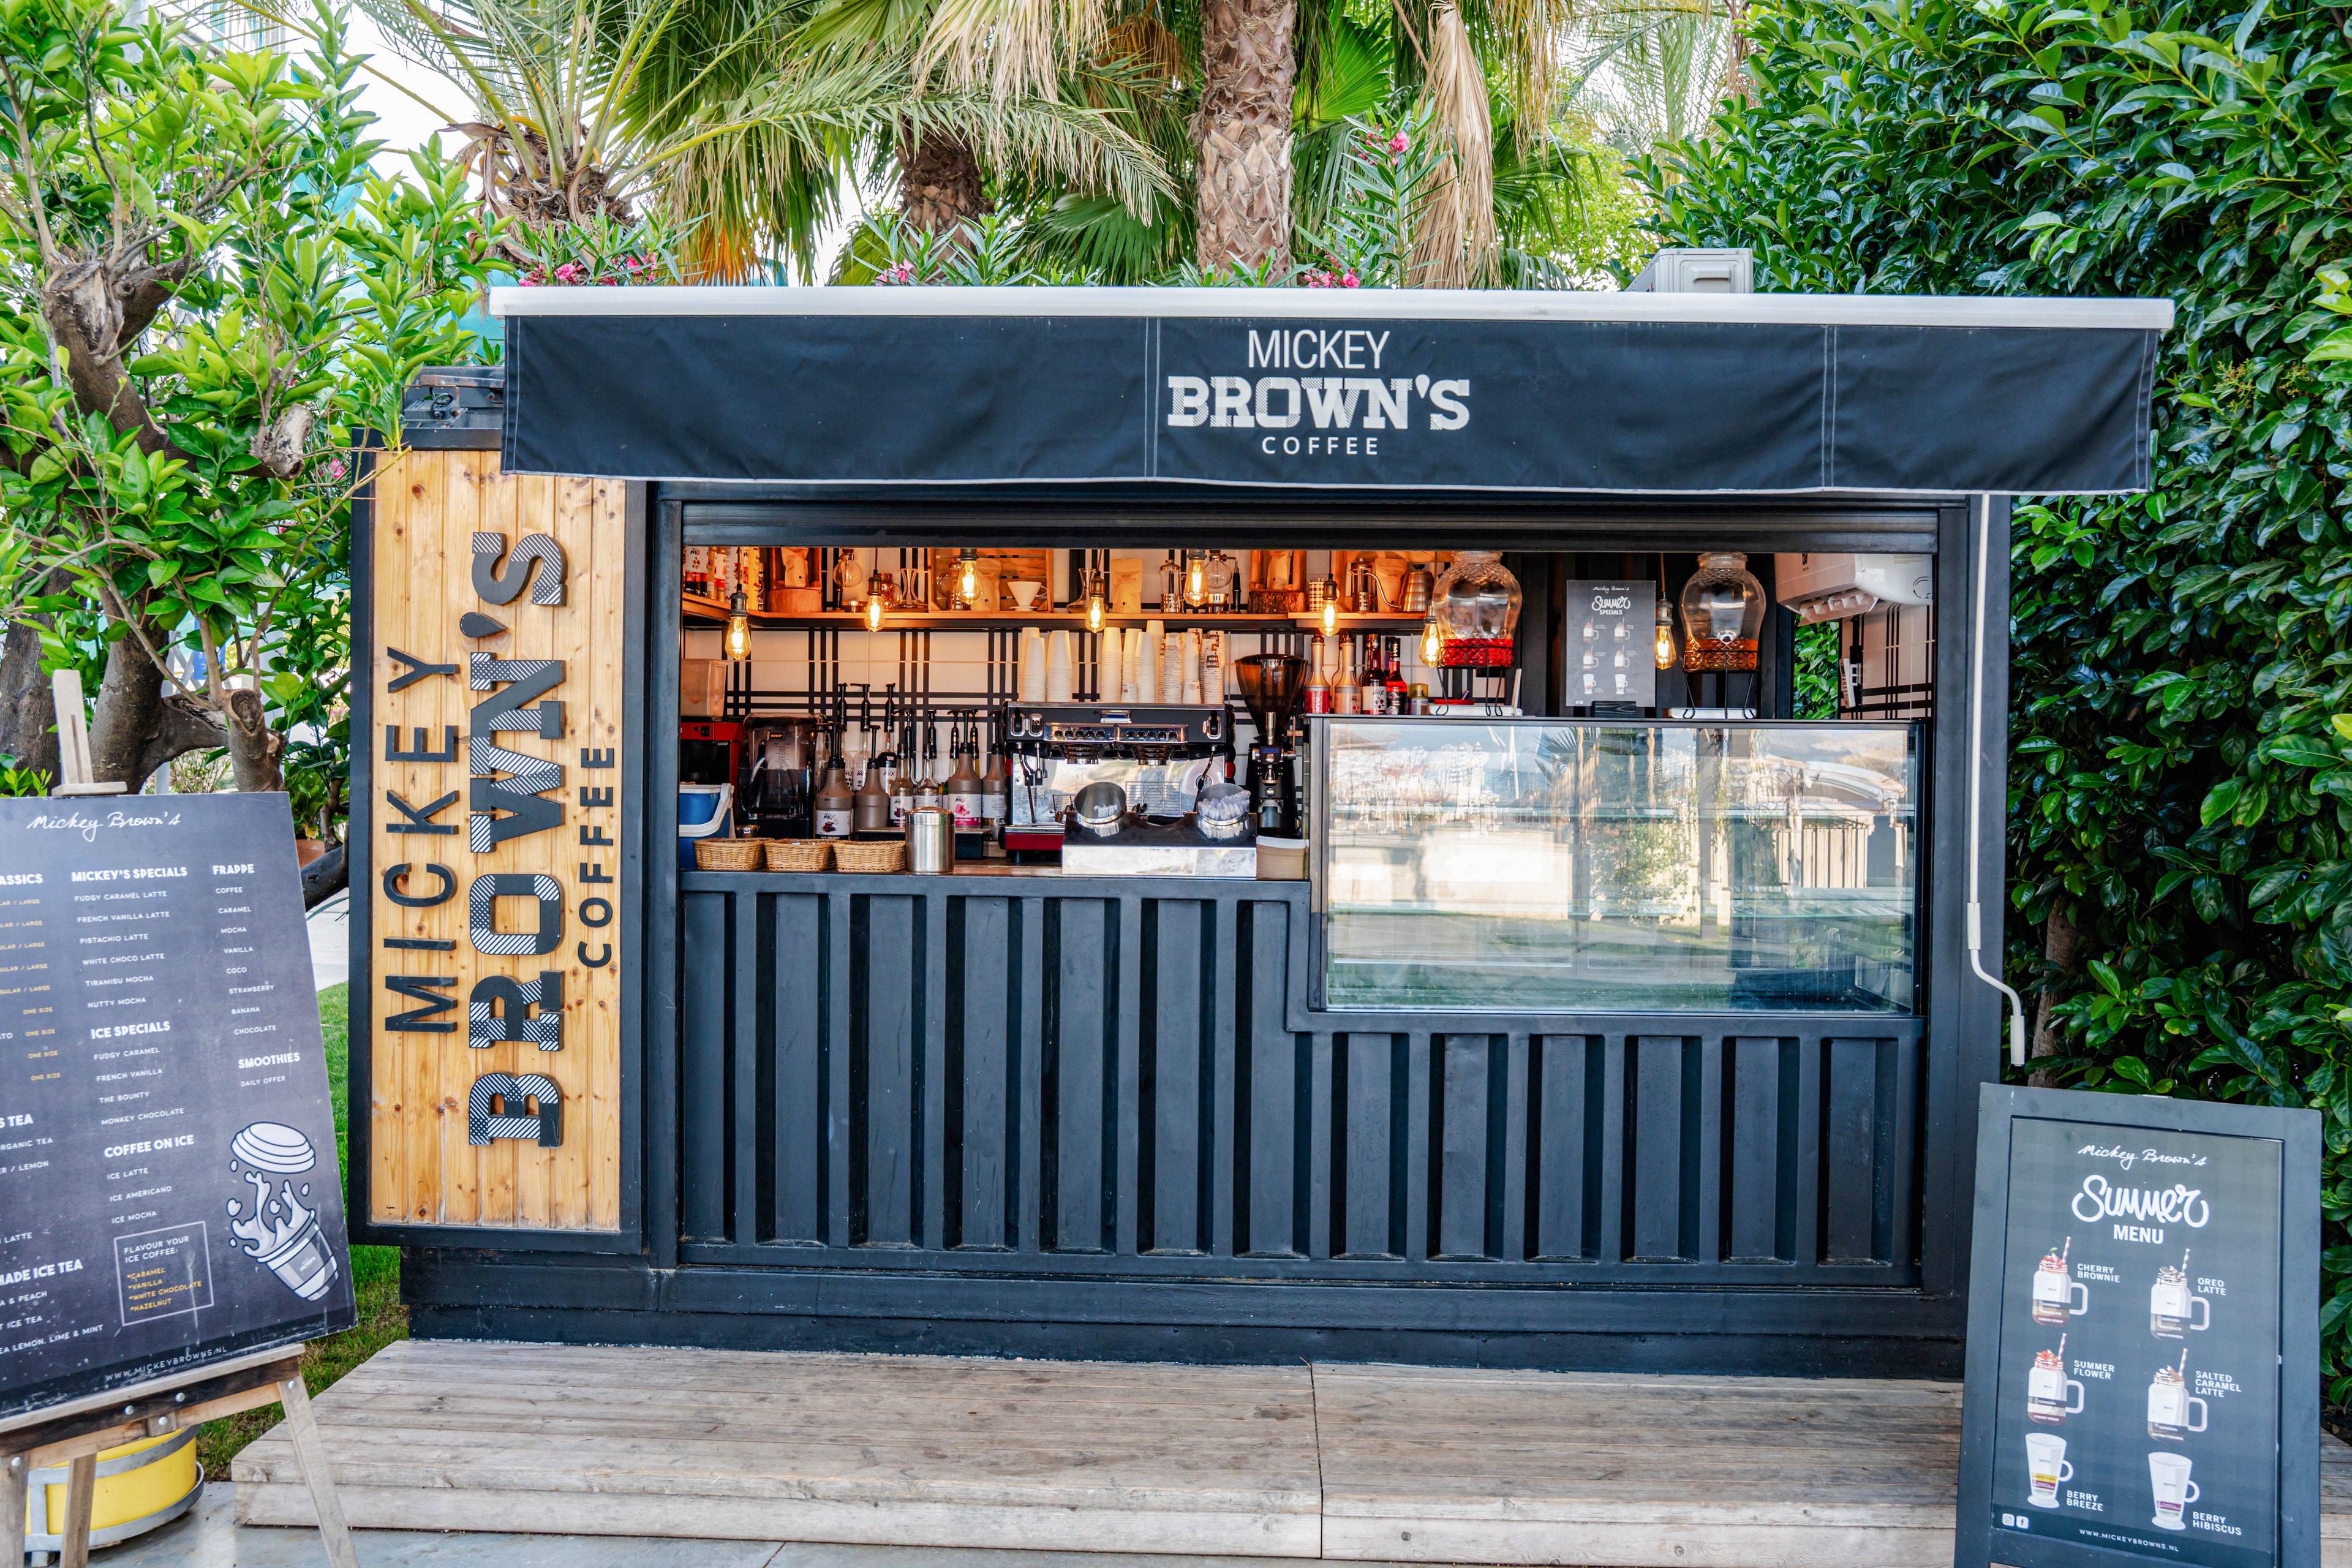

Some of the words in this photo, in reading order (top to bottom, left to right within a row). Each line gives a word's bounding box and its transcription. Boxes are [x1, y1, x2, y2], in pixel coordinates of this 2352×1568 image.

[1248, 330, 1390, 369] MICKEY
[1167, 374, 1470, 431] BROWN'S
[1262, 436, 1378, 455] COFFEE
[1591, 595, 1630, 611] Summer
[26, 812, 104, 842] Mickey
[107, 811, 181, 828] Brown's
[383, 646, 460, 1033] MICKEY
[459, 532, 567, 1149] BROWN'S
[578, 747, 614, 968] COFFEE
[71, 869, 131, 882] MICKEY'S
[133, 866, 188, 880] SPECIALS
[213, 864, 255, 875] FRAPPE
[80, 935, 122, 944] PISTACHIO
[85, 978, 124, 987] TIRAMISU
[126, 975, 154, 984] MOCHA
[229, 985, 274, 994] STRAWBERRY
[118, 997, 147, 1006] MOCHA
[231, 1006, 260, 1015] BANANA
[91, 1027, 112, 1039] ICE
[114, 1020, 171, 1037] SPECIALS
[234, 1025, 277, 1035] CHOCOLATE
[94, 1052, 121, 1060] FUDGY
[123, 1047, 160, 1057] CARAMEL
[238, 1052, 300, 1069] SMOOTHIES
[96, 1072, 128, 1082] FRENCH
[130, 1068, 164, 1078] VANILLA
[241, 1079, 261, 1087] DAILY
[263, 1076, 286, 1084] OFFER
[118, 1091, 150, 1101] BOUNTY
[7, 1114, 34, 1127] TEA
[101, 1115, 135, 1126] MONKEY
[138, 1107, 185, 1120] CHOCOLATE
[104, 1141, 153, 1158] COFFEE
[153, 1137, 173, 1150] ON
[175, 1134, 195, 1147] ICE
[2078, 1145, 2139, 1170] Mickey
[2142, 1148, 2207, 1166] Brown's
[18, 1160, 49, 1171] LEMON
[123, 1167, 149, 1177] LATTE
[126, 1186, 172, 1199] AMERICANO
[2071, 1174, 2210, 1228] Summer
[128, 1210, 157, 1221] MOCHA
[4, 1232, 33, 1243] LATTE
[2113, 1224, 2164, 1245] MENU
[124, 1241, 164, 1254] FLAVOUR
[167, 1235, 189, 1245] YOUR
[125, 1255, 140, 1264] ICE
[33, 1264, 56, 1279] ICE
[58, 1259, 83, 1274] TEA
[2077, 1263, 2114, 1274] CHERRY
[2077, 1270, 2120, 1283] BROWNIE
[2197, 1277, 2225, 1287] OREO
[159, 1281, 202, 1295] CHOCOLATE
[2198, 1285, 2226, 1295] LATTE
[18, 1291, 48, 1303] PEACH
[7, 1319, 22, 1329] ICE
[24, 1316, 43, 1324] TEA
[49, 1332, 70, 1343] LIME
[82, 1324, 104, 1335] MINT
[105, 1346, 228, 1381] WWW.MICKEYBROWNS.NL
[2073, 1360, 2115, 1373] SUMMER
[2074, 1368, 2111, 1379] FLOWER
[2195, 1370, 2233, 1382] SALTED
[2195, 1378, 2242, 1392] CARAMEL
[2195, 1386, 2225, 1398] LATTE
[2067, 1490, 2098, 1502] BERRY
[2067, 1498, 2103, 1512] BREEZE
[2192, 1511, 2226, 1524] BERRY
[2193, 1520, 2242, 1536] HIBISCUS
[2079, 1529, 2179, 1552] WWW.MICKEYBROWNS.NL
